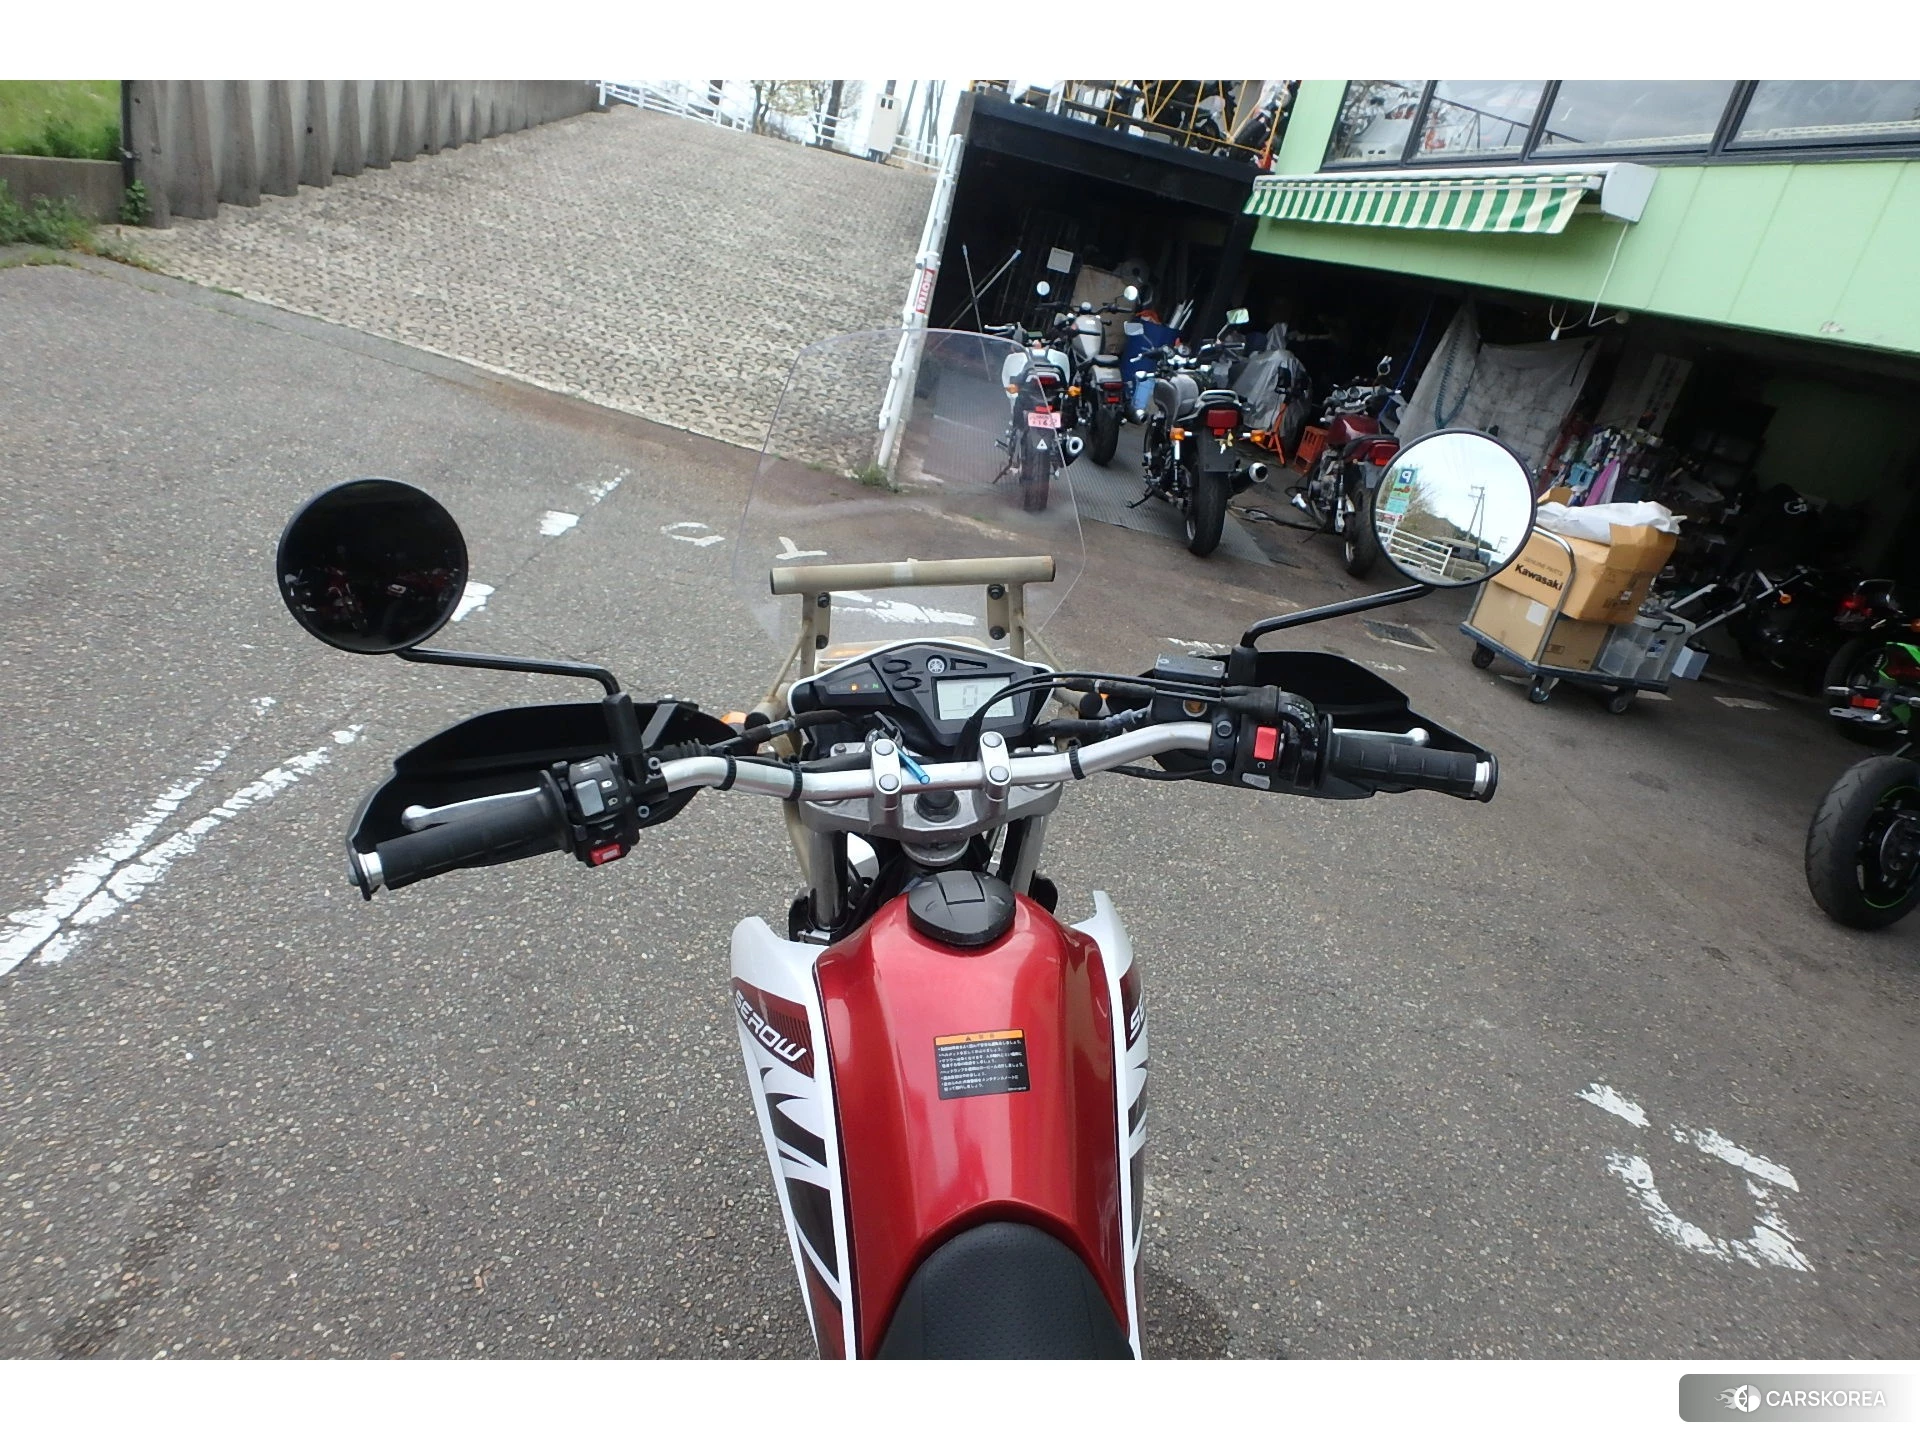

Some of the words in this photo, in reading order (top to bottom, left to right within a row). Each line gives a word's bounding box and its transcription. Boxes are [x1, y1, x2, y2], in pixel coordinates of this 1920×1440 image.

[917, 270, 933, 310] MOTUL
[1515, 563, 1564, 591] Kawasaki
[734, 989, 807, 1062] SEROW
